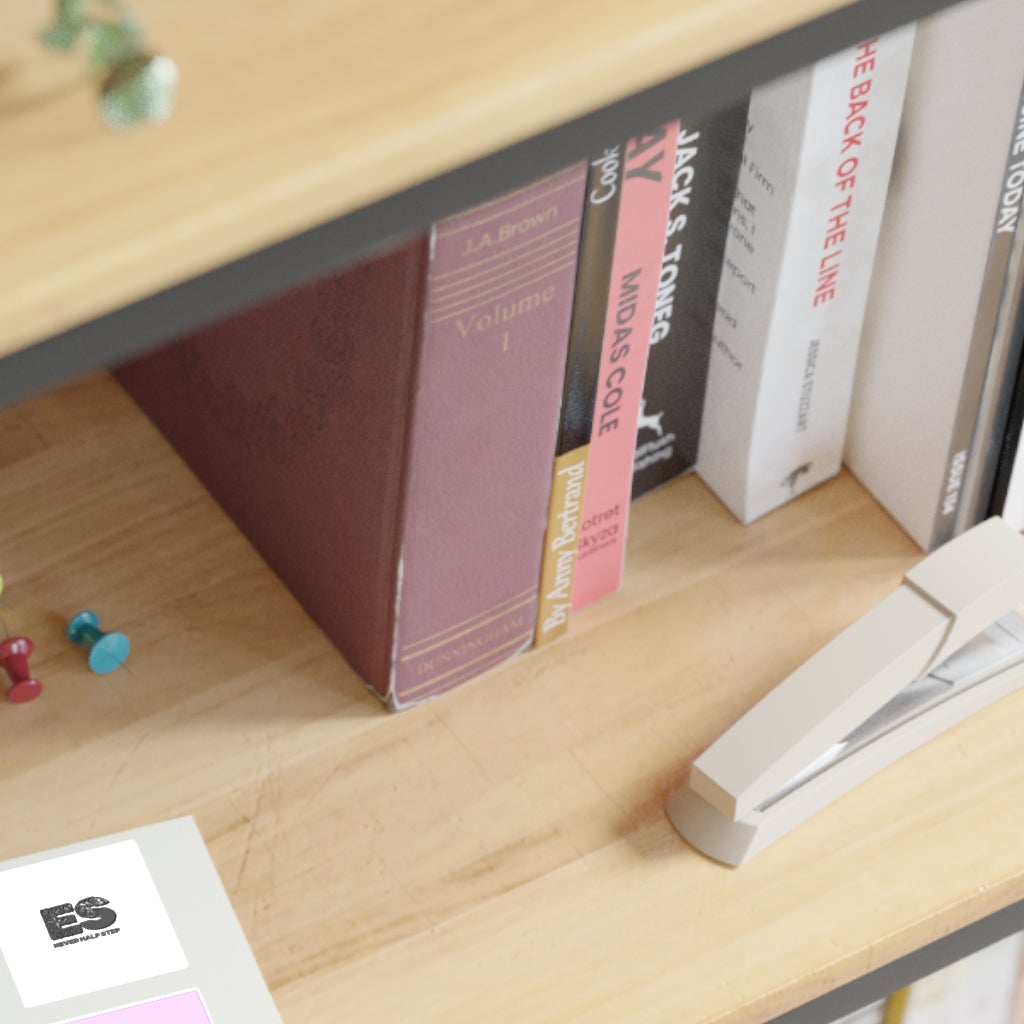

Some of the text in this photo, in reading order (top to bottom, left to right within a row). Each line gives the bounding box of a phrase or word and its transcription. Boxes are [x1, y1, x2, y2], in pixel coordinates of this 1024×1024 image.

[840, 79, 873, 154] BACK
[589, 144, 620, 205] Cook
[670, 129, 700, 206] JACK
[834, 156, 859, 191] OF
[823, 194, 853, 250] THE
[997, 160, 1024, 234] TODAY
[462, 204, 558, 257] J.A.Brown
[812, 249, 843, 308] LINE
[454, 285, 555, 338] Volume
[598, 266, 642, 437] MIDAS COLE
[551, 460, 585, 551] Bertrand
[577, 523, 619, 553] kyza
[542, 602, 573, 634] By
[40, 896, 117, 941] ES
[53, 927, 121, 948] NEVER HALF STEP
